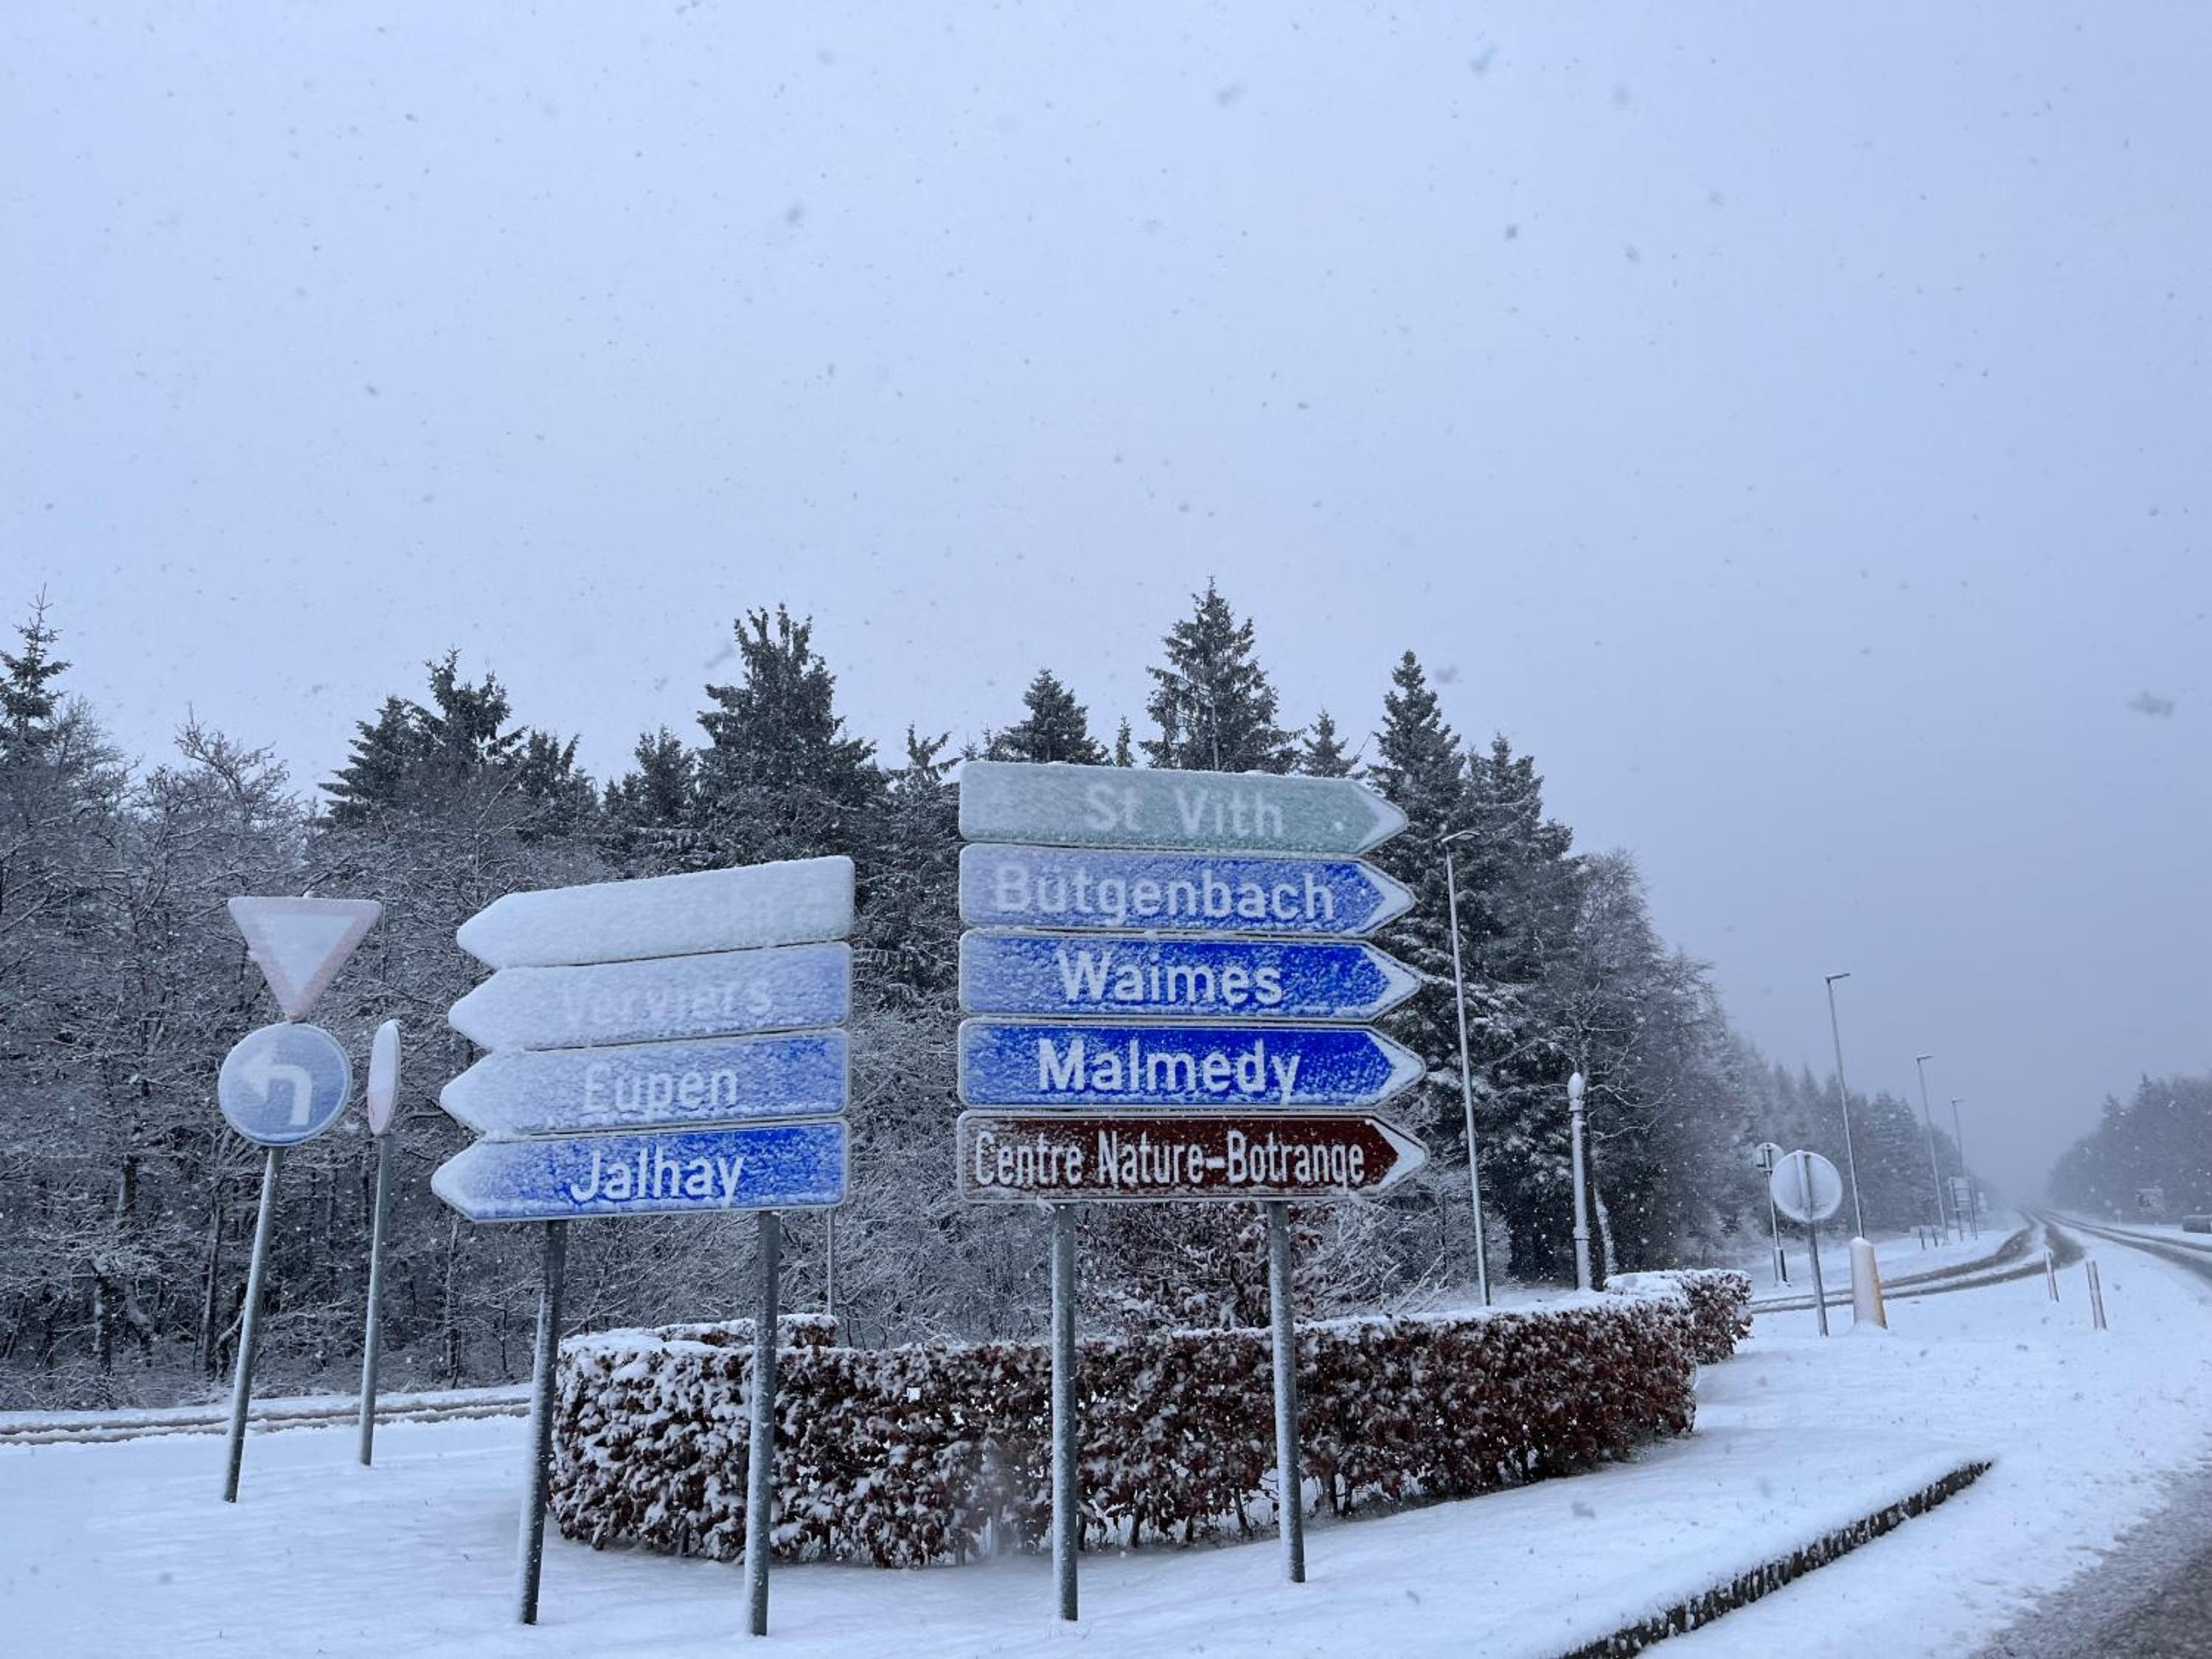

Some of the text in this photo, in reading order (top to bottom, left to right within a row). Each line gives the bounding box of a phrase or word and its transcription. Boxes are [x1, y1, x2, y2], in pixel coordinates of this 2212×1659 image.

[1082, 782, 1284, 838] St Vith
[995, 860, 1334, 925] Bütgenbach
[1057, 949, 1284, 1005] Waimes
[583, 1065, 739, 1119] Eupen
[1037, 1037, 1301, 1105] Malmedy
[569, 1147, 745, 1208] Jalhay
[974, 1130, 1366, 1190] Centre Nature-Botrange
